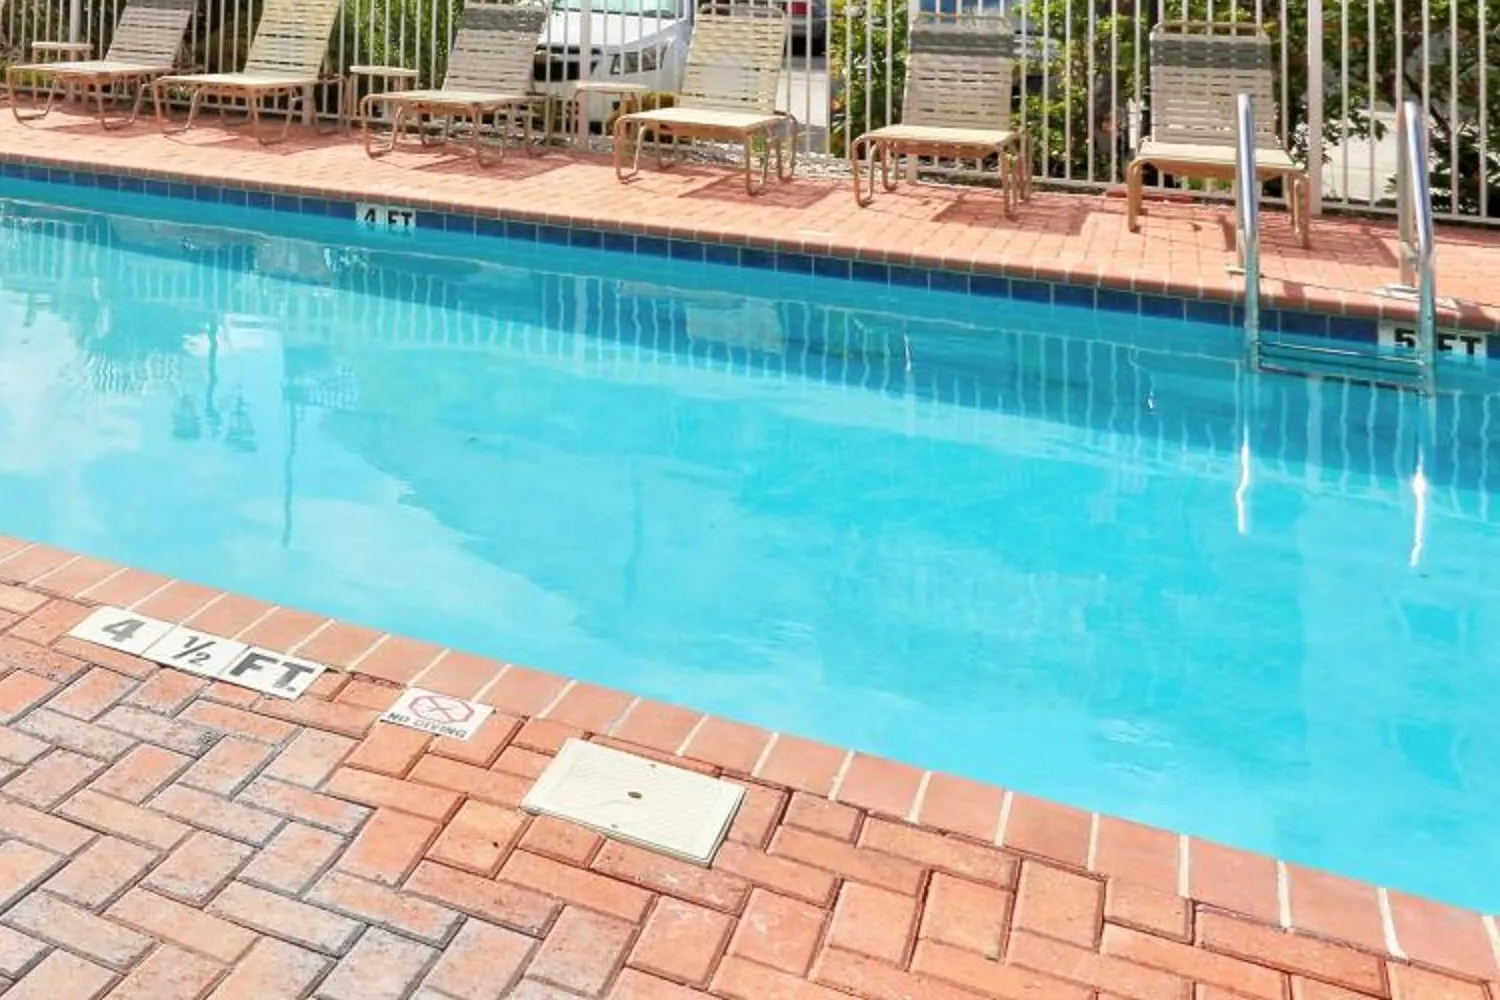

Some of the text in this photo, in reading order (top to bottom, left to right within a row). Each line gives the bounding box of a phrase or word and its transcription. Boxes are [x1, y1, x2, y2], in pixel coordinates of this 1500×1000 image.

[387, 210, 413, 227] FT
[1395, 327, 1482, 355] 5 FT
[102, 618, 146, 643] 4
[387, 712, 468, 738] NO DIVING
